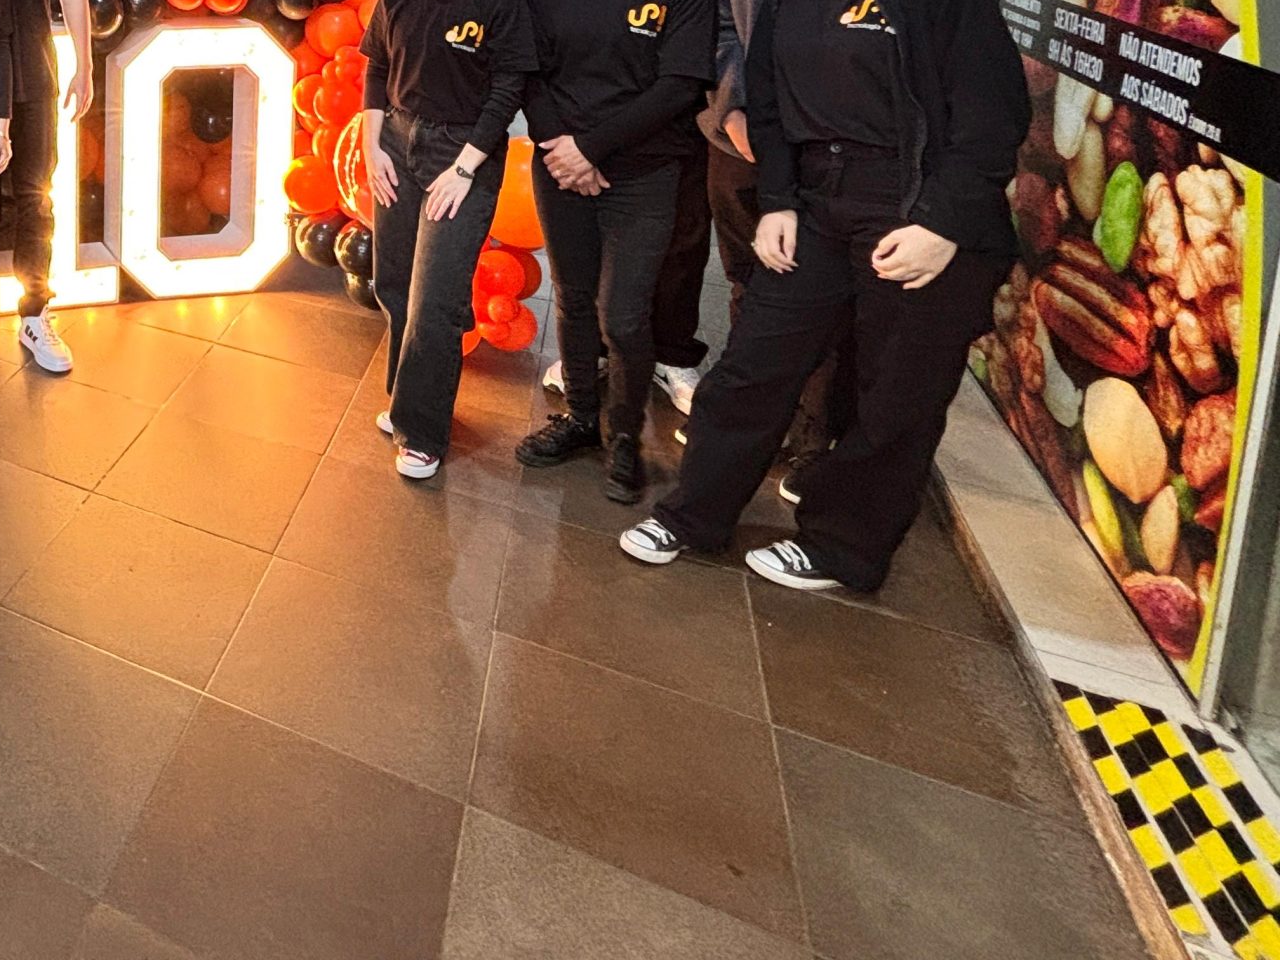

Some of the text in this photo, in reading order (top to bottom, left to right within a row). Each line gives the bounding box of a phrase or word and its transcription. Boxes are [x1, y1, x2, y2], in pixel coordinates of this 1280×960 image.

[1054, 7, 1105, 45] SEXTA-FEIRA
[1073, 50, 1104, 82] 16H30
[1119, 31, 1203, 87] NÃO ATENDEMOS
[1120, 73, 1190, 126] AOS SÁBADOS
